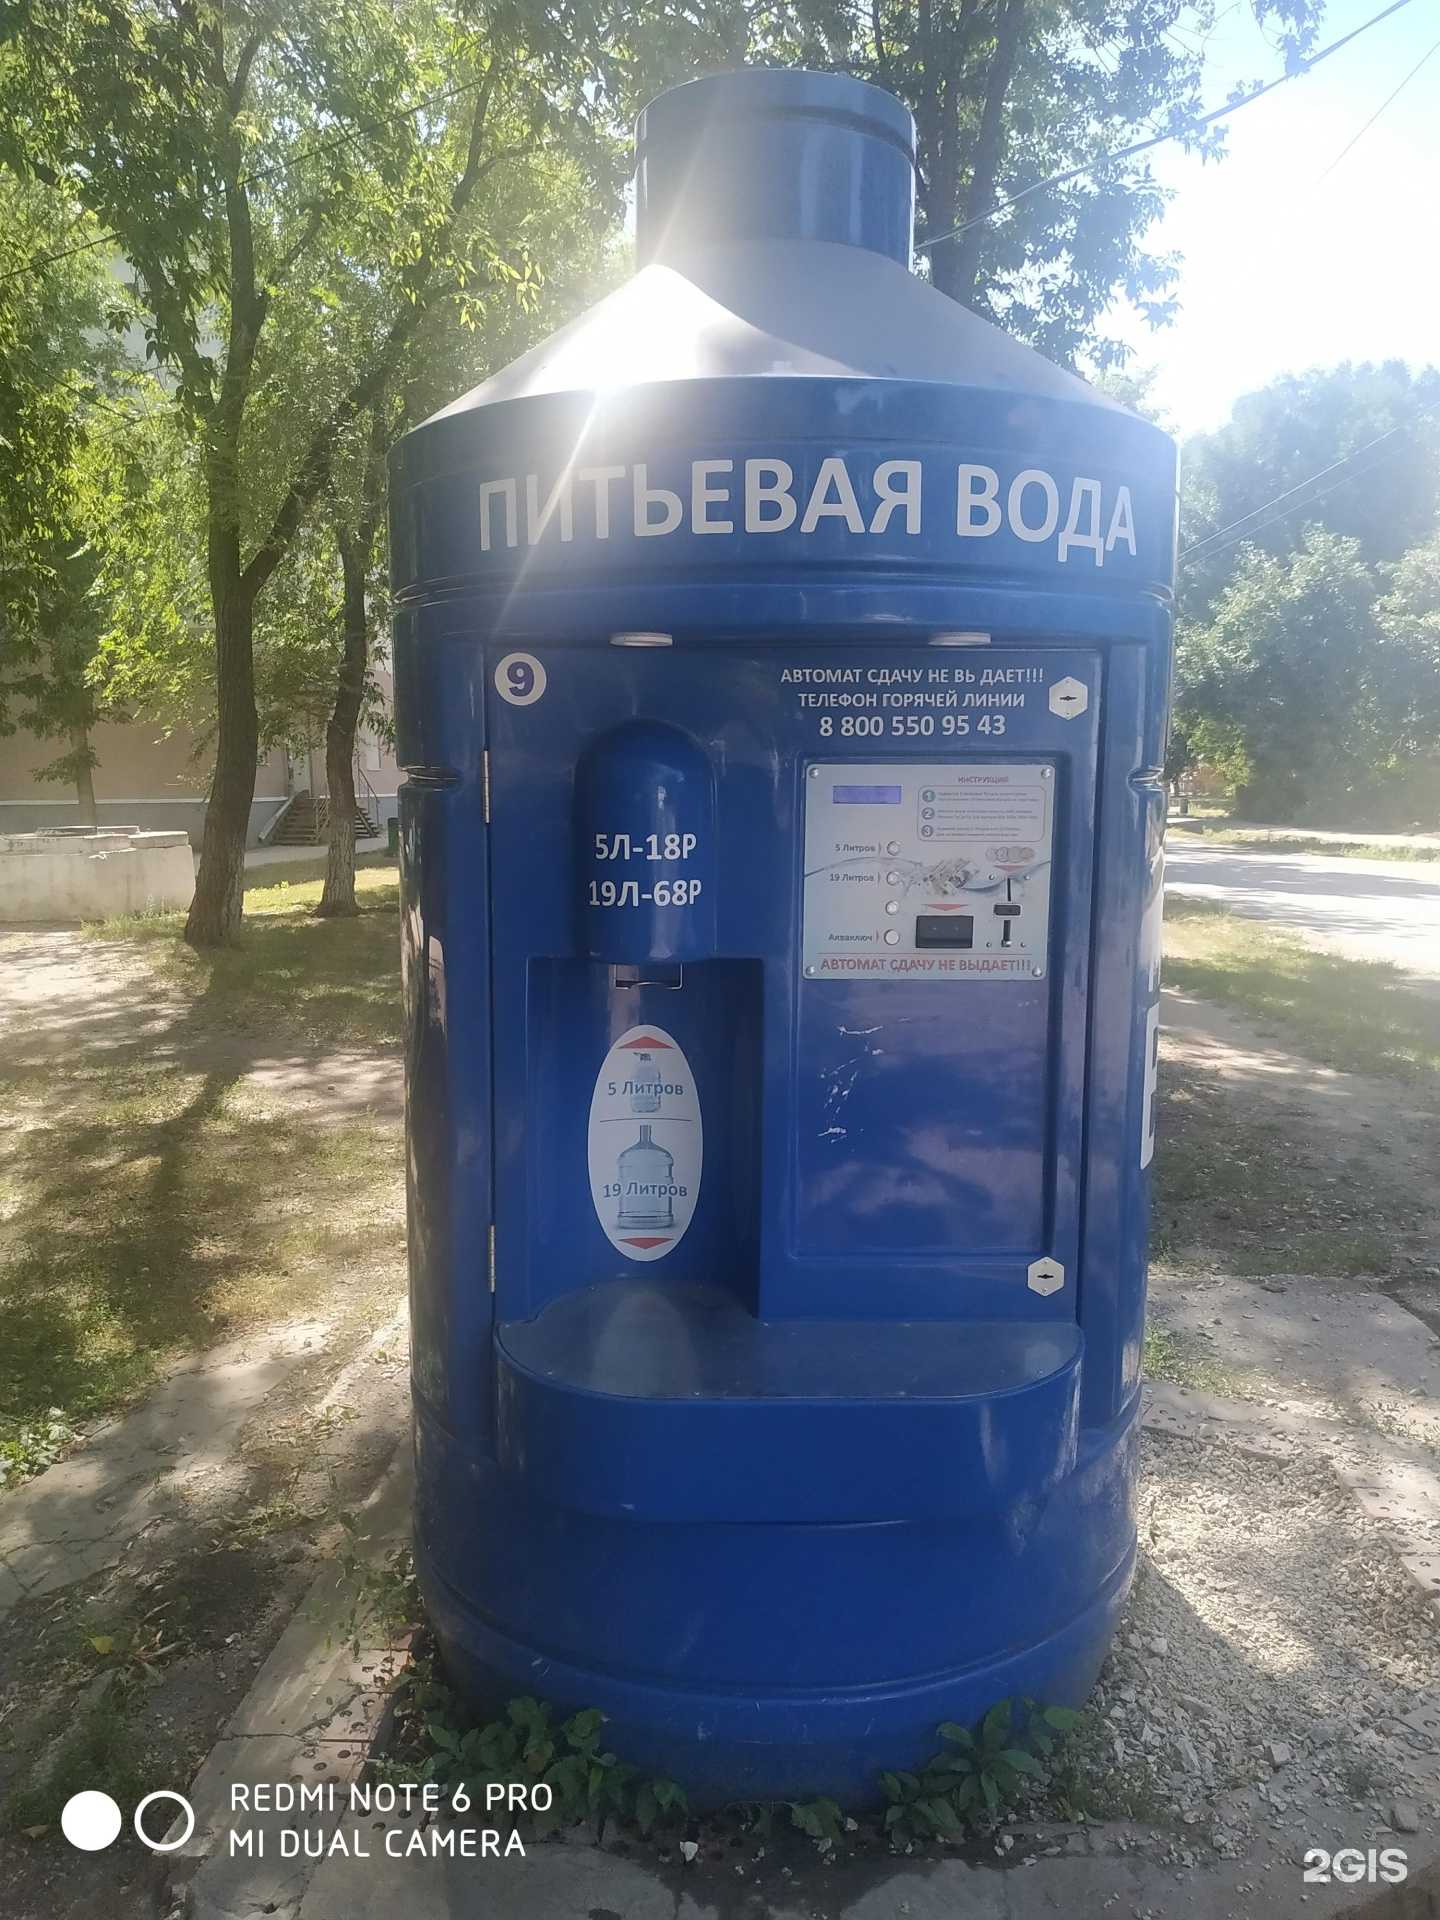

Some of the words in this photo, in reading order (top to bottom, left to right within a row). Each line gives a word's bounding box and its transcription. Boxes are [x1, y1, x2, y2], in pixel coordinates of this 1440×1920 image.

[478, 457, 922, 552] ПИТЬЕВАЯ
[956, 462, 1138, 567] ВОДА
[507, 661, 535, 697] 9
[780, 668, 863, 684] АВТОМАТ
[867, 668, 924, 685] СДАЧУ
[928, 669, 949, 683] НЕ
[798, 692, 877, 708] ТЕЛЕФОН
[882, 690, 957, 708] ГОРЯЧЕЙ
[962, 693, 1025, 708] ЛИНИИ
[819, 716, 833, 736] 8
[840, 716, 884, 737] 800
[891, 715, 934, 736] 550
[941, 715, 970, 736] 95
[976, 714, 1006, 736] 43
[595, 833, 697, 860] 5Л-18Р
[843, 844, 876, 853] Литров
[830, 873, 840, 881] 19
[842, 873, 874, 883] Литров
[589, 879, 702, 907] 19Л-68Р
[820, 959, 887, 970] АВТОМАТ
[892, 959, 935, 973] СДАЧУ
[938, 960, 956, 971] НЕ
[959, 960, 1032, 973] ВЫДАЕТ!!!
[607, 1082, 617, 1096] 5
[622, 1081, 684, 1098] Литров
[603, 1183, 622, 1199] 19
[625, 1181, 688, 1199] Литров
